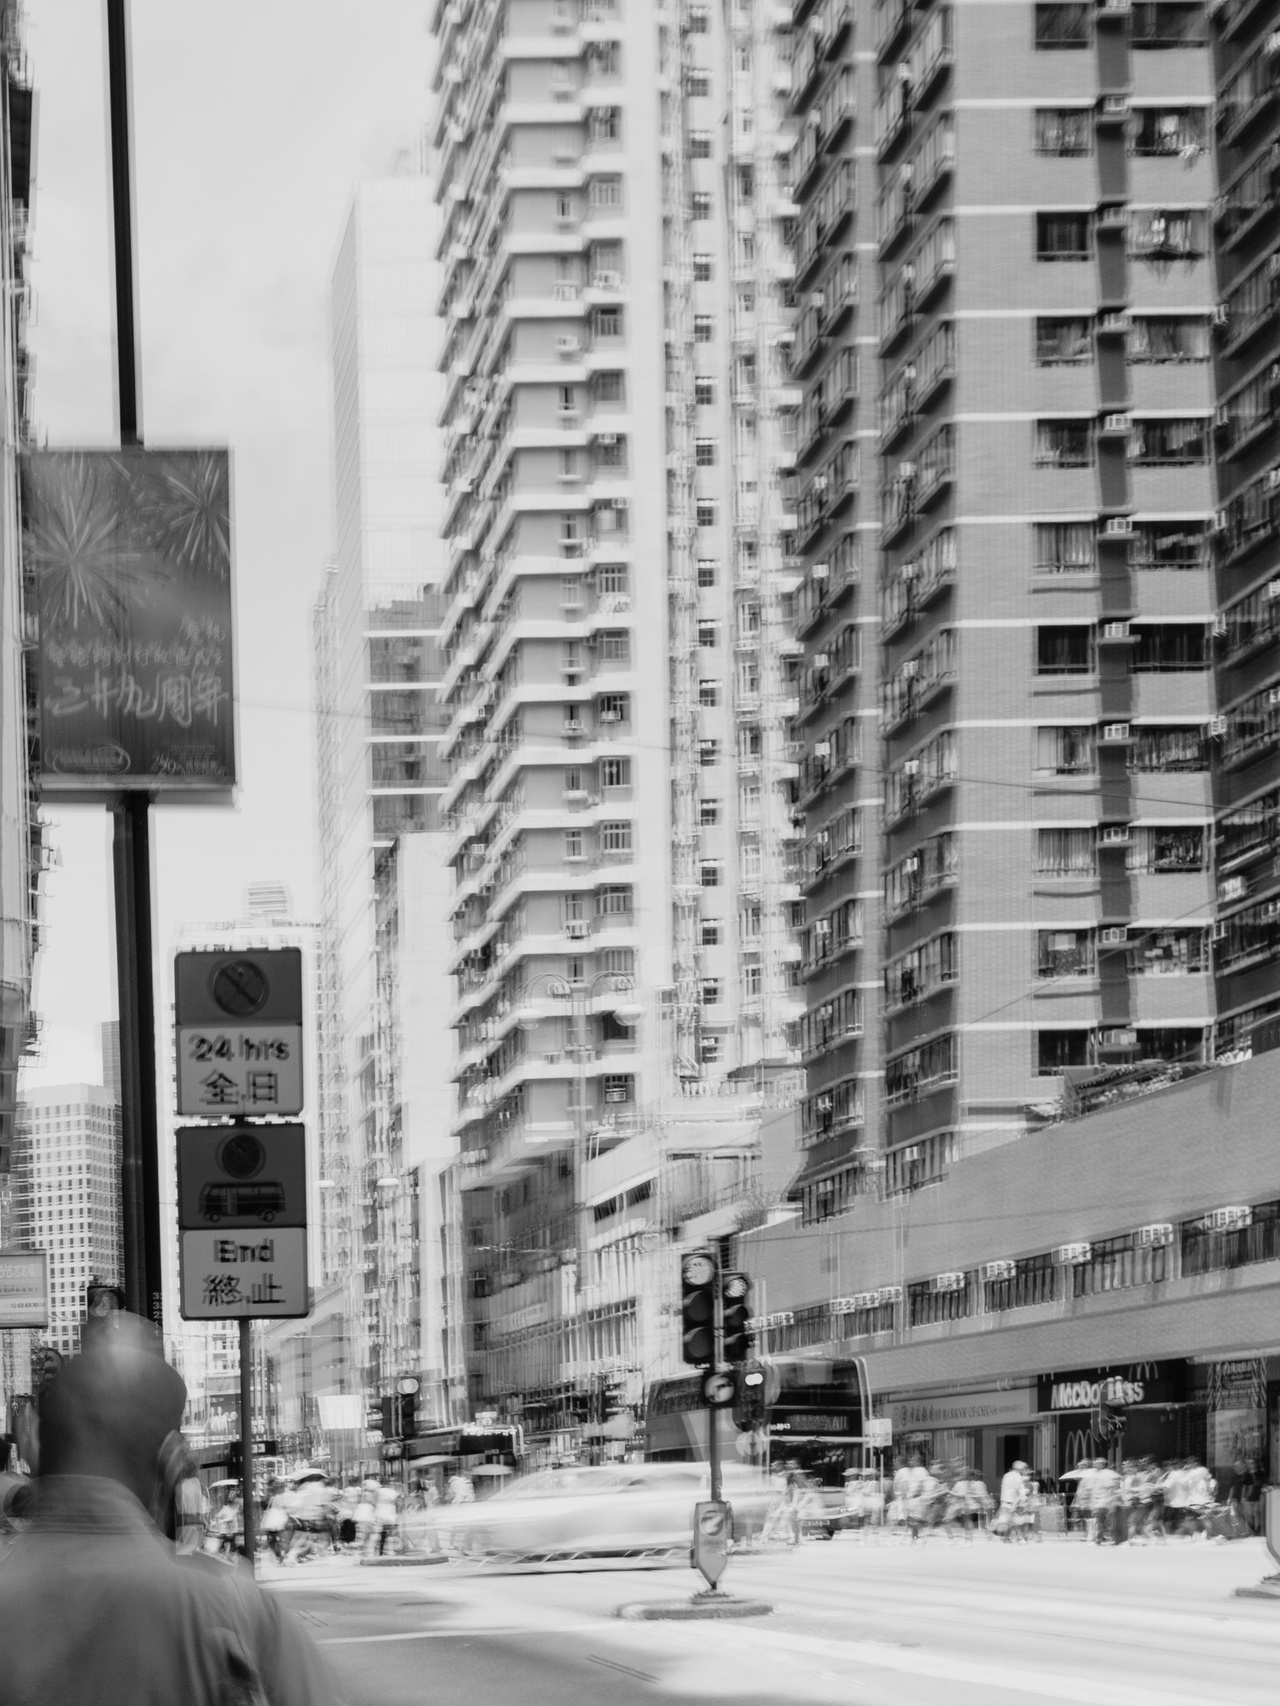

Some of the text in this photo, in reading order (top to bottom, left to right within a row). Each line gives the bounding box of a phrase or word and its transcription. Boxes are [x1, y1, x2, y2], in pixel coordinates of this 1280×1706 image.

[188, 1036, 290, 1061] 24 hrs
[201, 1070, 279, 1104] 全日
[214, 1239, 274, 1263] End
[203, 1274, 286, 1306] 終止
